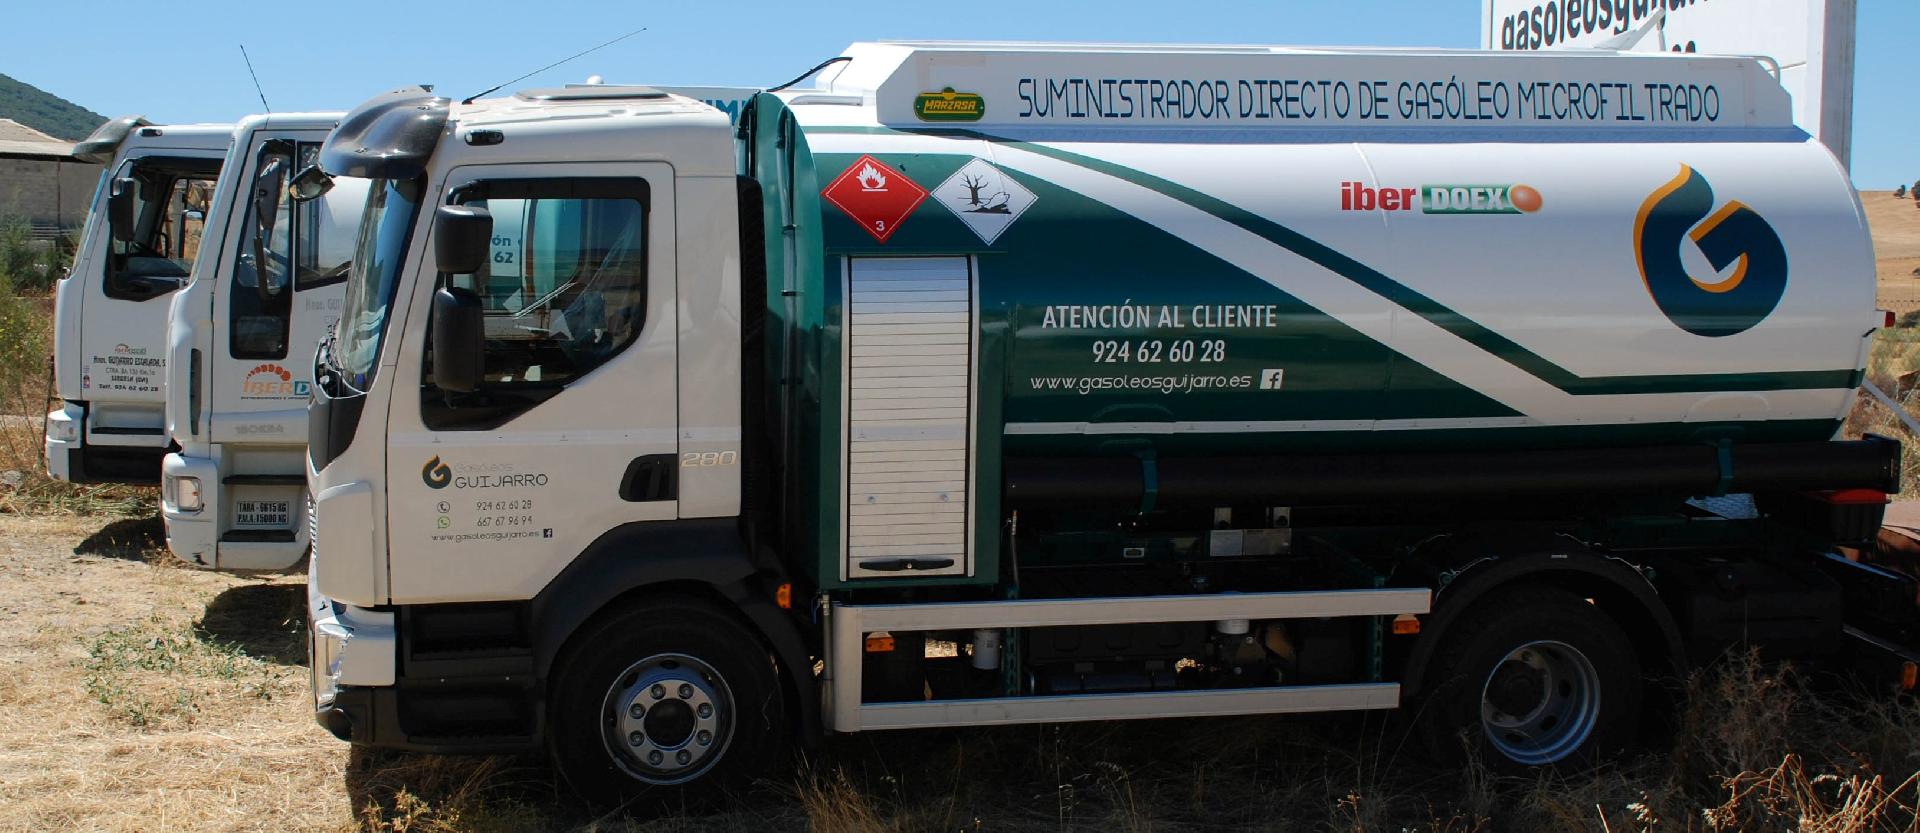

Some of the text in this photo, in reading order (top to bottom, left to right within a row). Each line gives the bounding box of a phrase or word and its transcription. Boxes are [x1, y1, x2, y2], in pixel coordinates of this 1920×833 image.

[925, 99, 977, 113] MARZASA
[1018, 75, 1720, 122] SUMINISTRADOR DIRECTO DE GASÓLEO MICROFILTRADO
[1341, 181, 1504, 211] iber DOEX
[875, 220, 885, 231] 3
[494, 251, 514, 264] 62
[1042, 298, 1277, 329] ATENCIÓN AL CLIENTE
[1092, 340, 1225, 363] 924 62 60 28
[1030, 373, 1252, 395] www.gasoleosguijarro.es
[681, 450, 737, 468] 280
[454, 473, 549, 489] GUIJARRO
[239, 503, 255, 513] TARA
[476, 499, 532, 511] 924 62 60 28
[477, 517, 493, 527] 667
[495, 516, 506, 526] 67
[508, 516, 519, 525] 96
